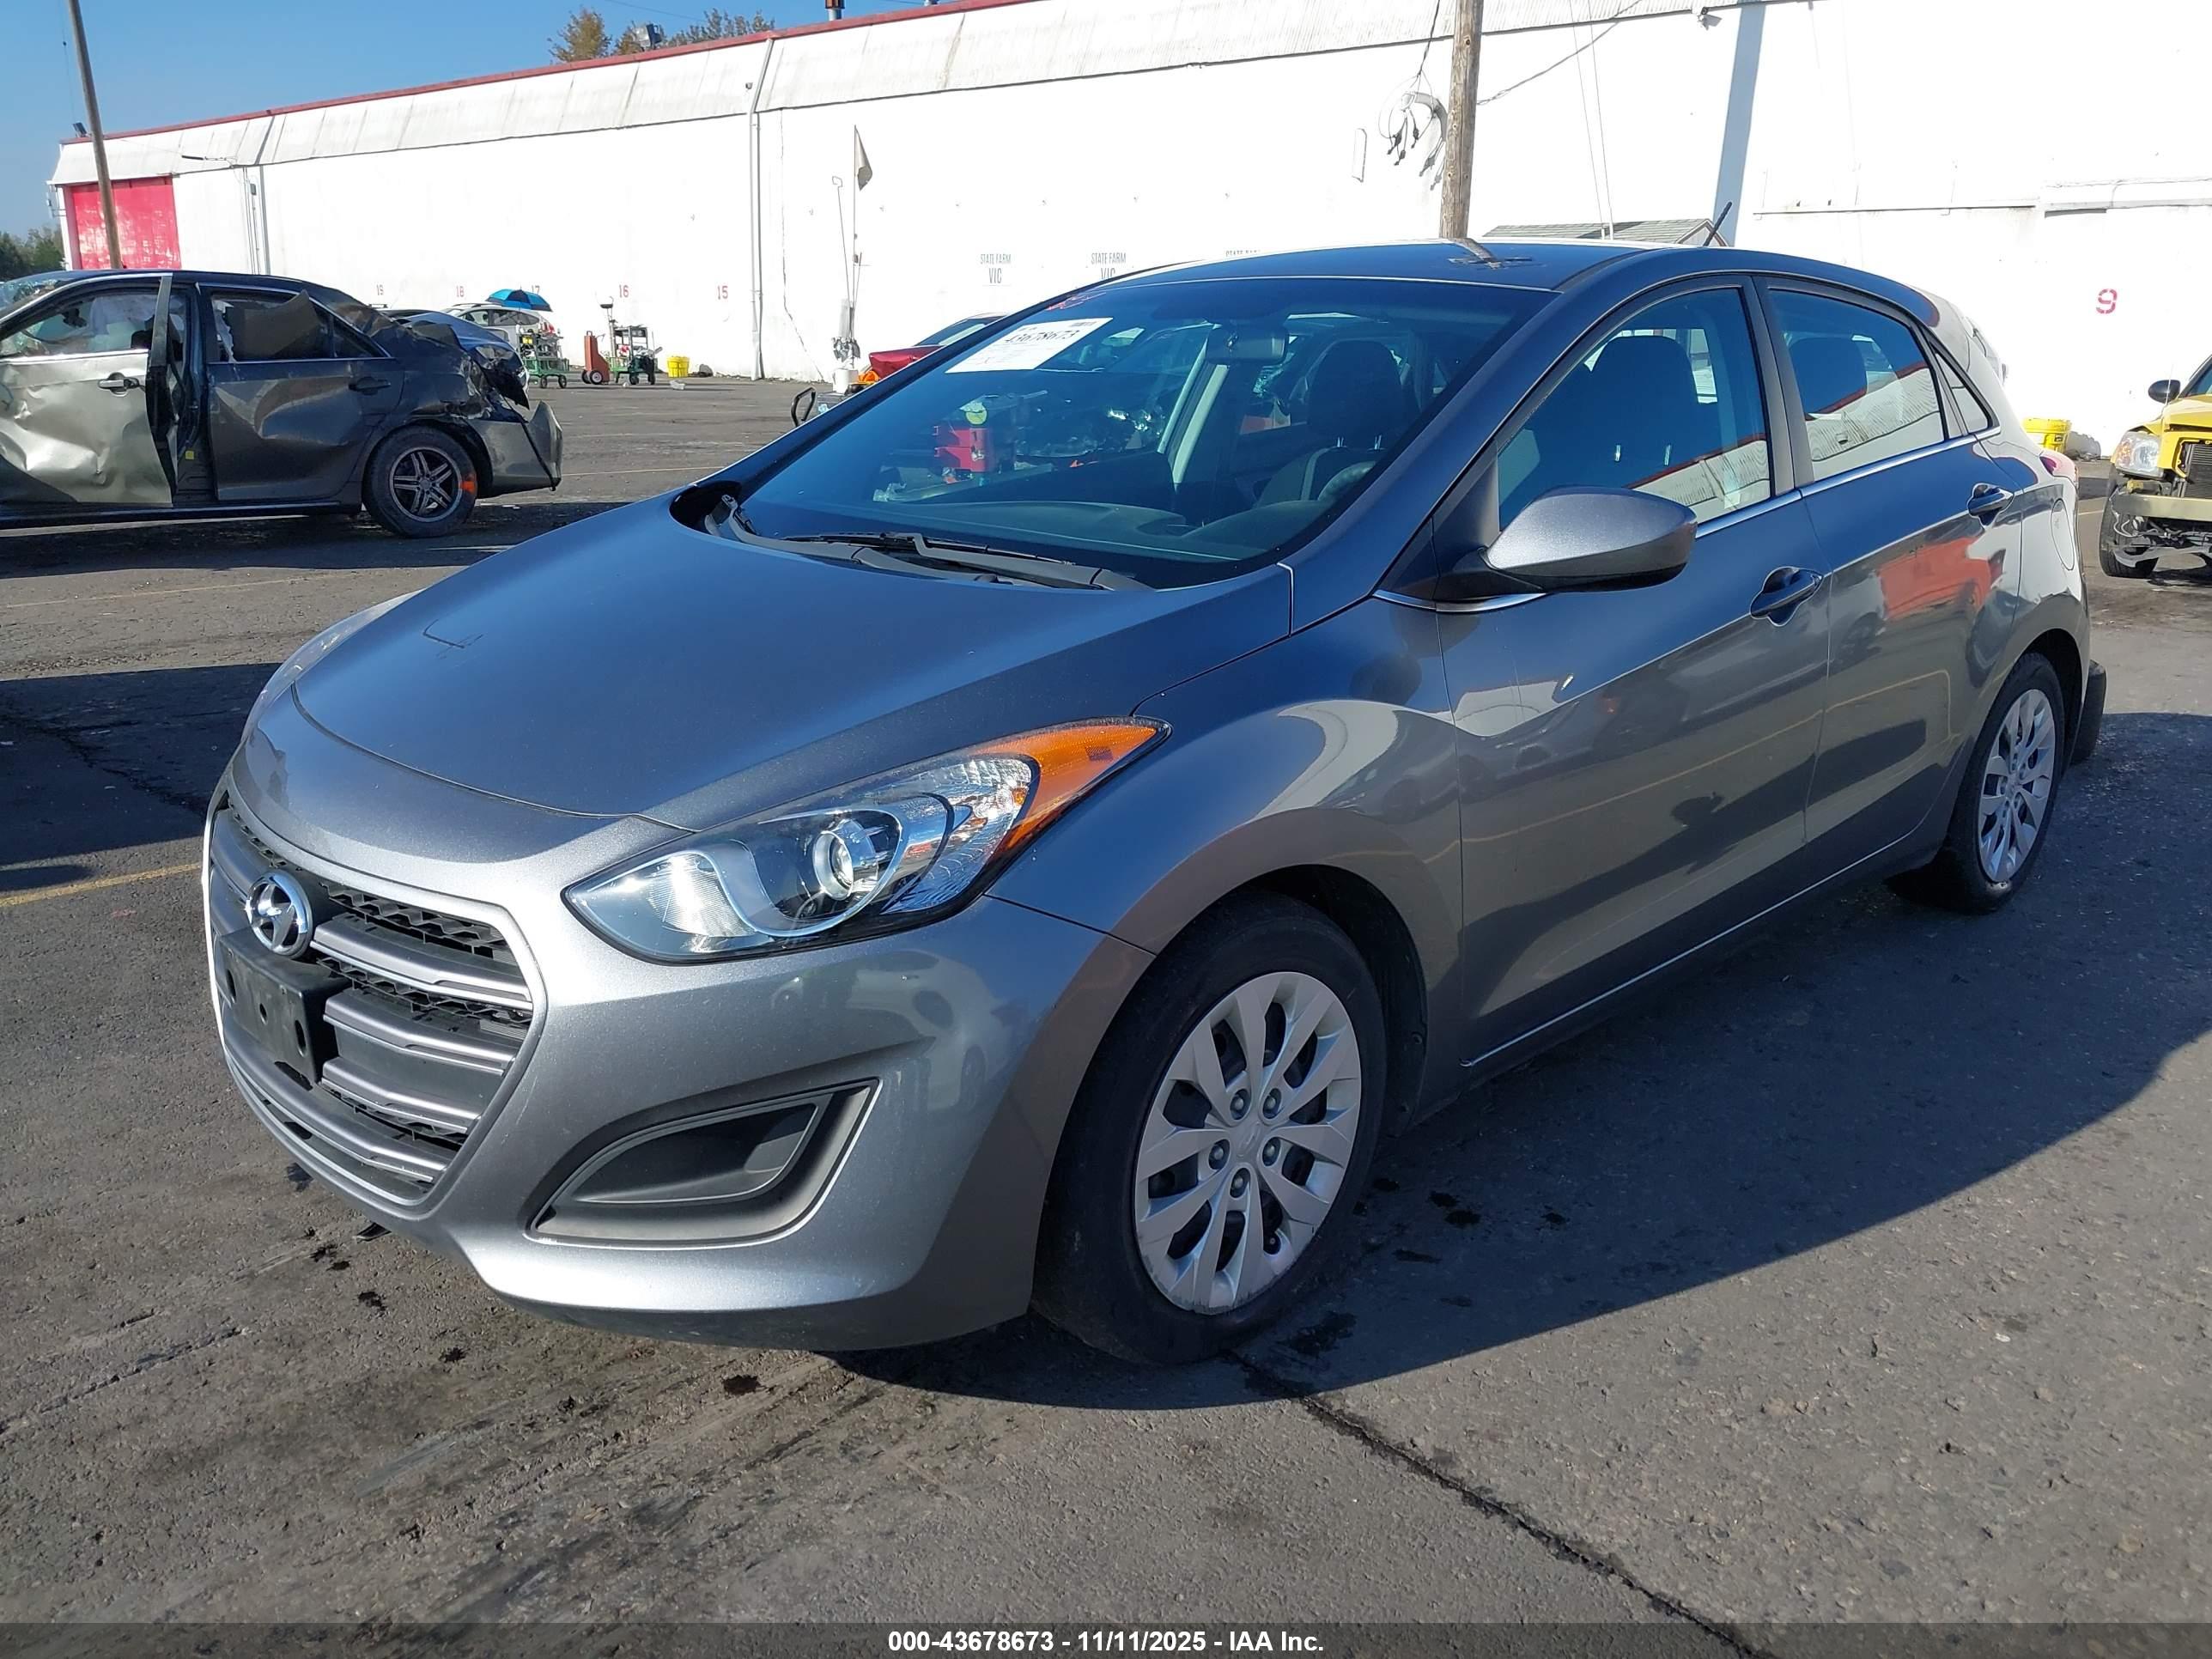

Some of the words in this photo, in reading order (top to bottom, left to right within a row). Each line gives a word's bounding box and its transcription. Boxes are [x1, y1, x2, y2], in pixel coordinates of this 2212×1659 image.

[980, 253, 994, 264] STATE
[995, 253, 1012, 264] FARM
[1091, 252, 1108, 264] STATE
[1109, 252, 1127, 264] FARM
[988, 268, 1002, 283] VIC
[456, 285, 465, 297] 18
[532, 284, 540, 295] 17
[619, 284, 629, 298] 16
[717, 285, 729, 300] 15
[2096, 289, 2118, 314] 9
